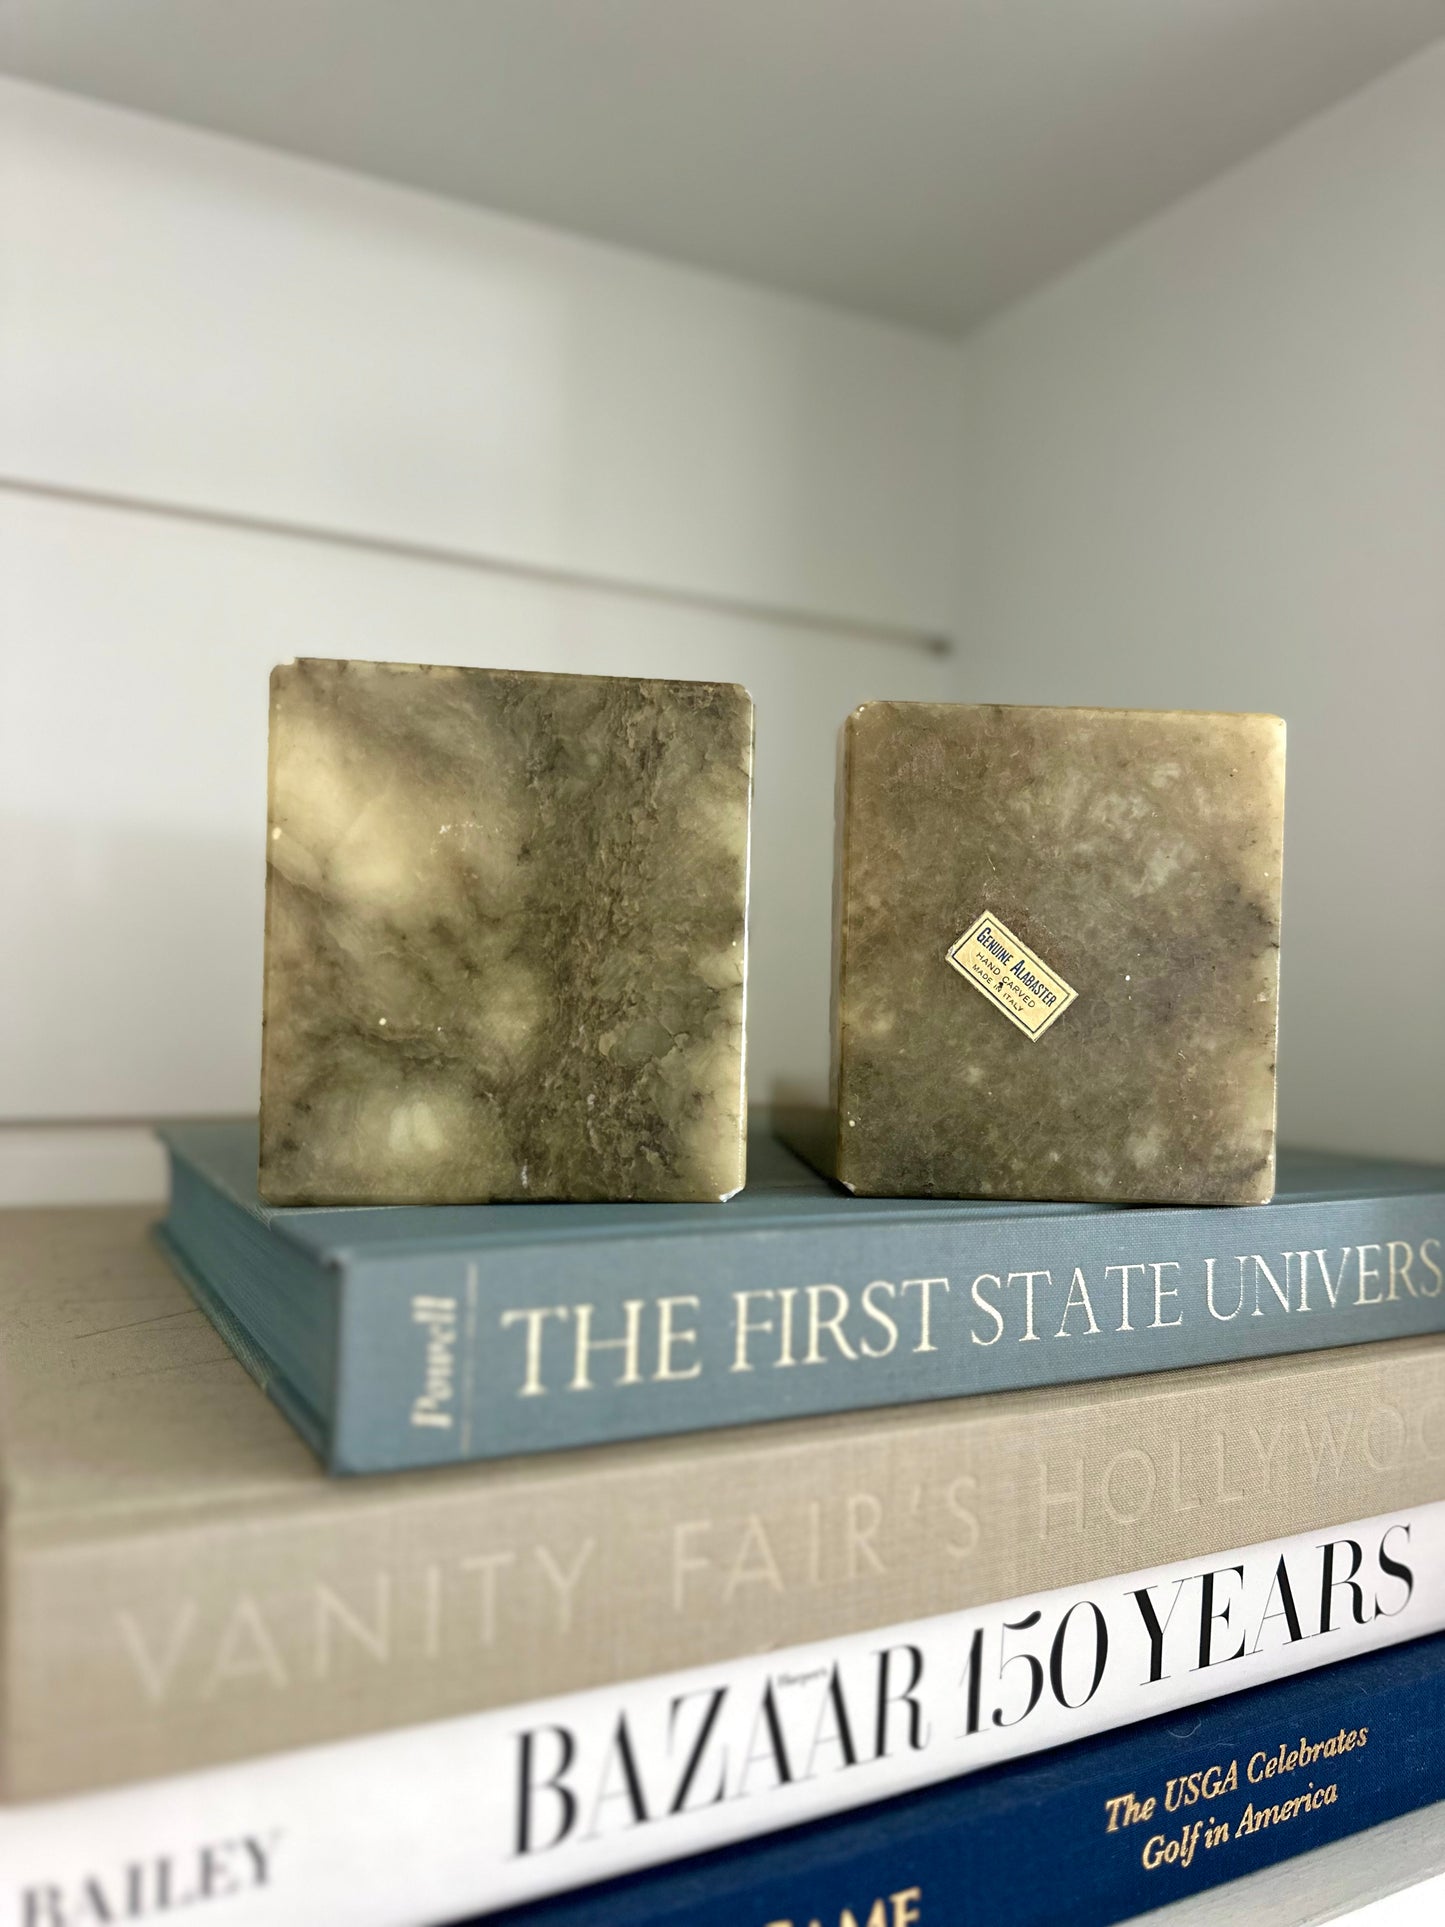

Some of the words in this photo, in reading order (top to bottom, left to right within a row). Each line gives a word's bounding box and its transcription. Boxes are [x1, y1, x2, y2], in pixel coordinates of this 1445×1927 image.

[972, 964, 993, 984] MADE
[1003, 992, 1024, 1012] ITALY
[976, 952, 1001, 976] HAND
[1001, 976, 1036, 1008] CARVED
[977, 927, 1014, 966] GENUINE
[1010, 960, 1057, 1007] ALABASTER
[502, 1296, 702, 1397] THE
[730, 1277, 950, 1373] FIRST
[970, 1261, 1184, 1347] STATE
[1204, 1238, 1443, 1322] UNIVERS
[115, 1536, 596, 1705] VANITY
[672, 1475, 981, 1613] FAIR'S
[506, 1643, 932, 1860] BAZAAR
[955, 1600, 1109, 1739] 150
[1123, 1524, 1414, 1686] YEARS
[1105, 1792, 1157, 1833] The
[1164, 1759, 1239, 1823] USGA
[1246, 1726, 1369, 1784] Celebrates
[1141, 1819, 1204, 1870] Golf
[1204, 1817, 1230, 1848] in
[1234, 1782, 1338, 1838] America
[17, 1826, 284, 1927] BAILEY
